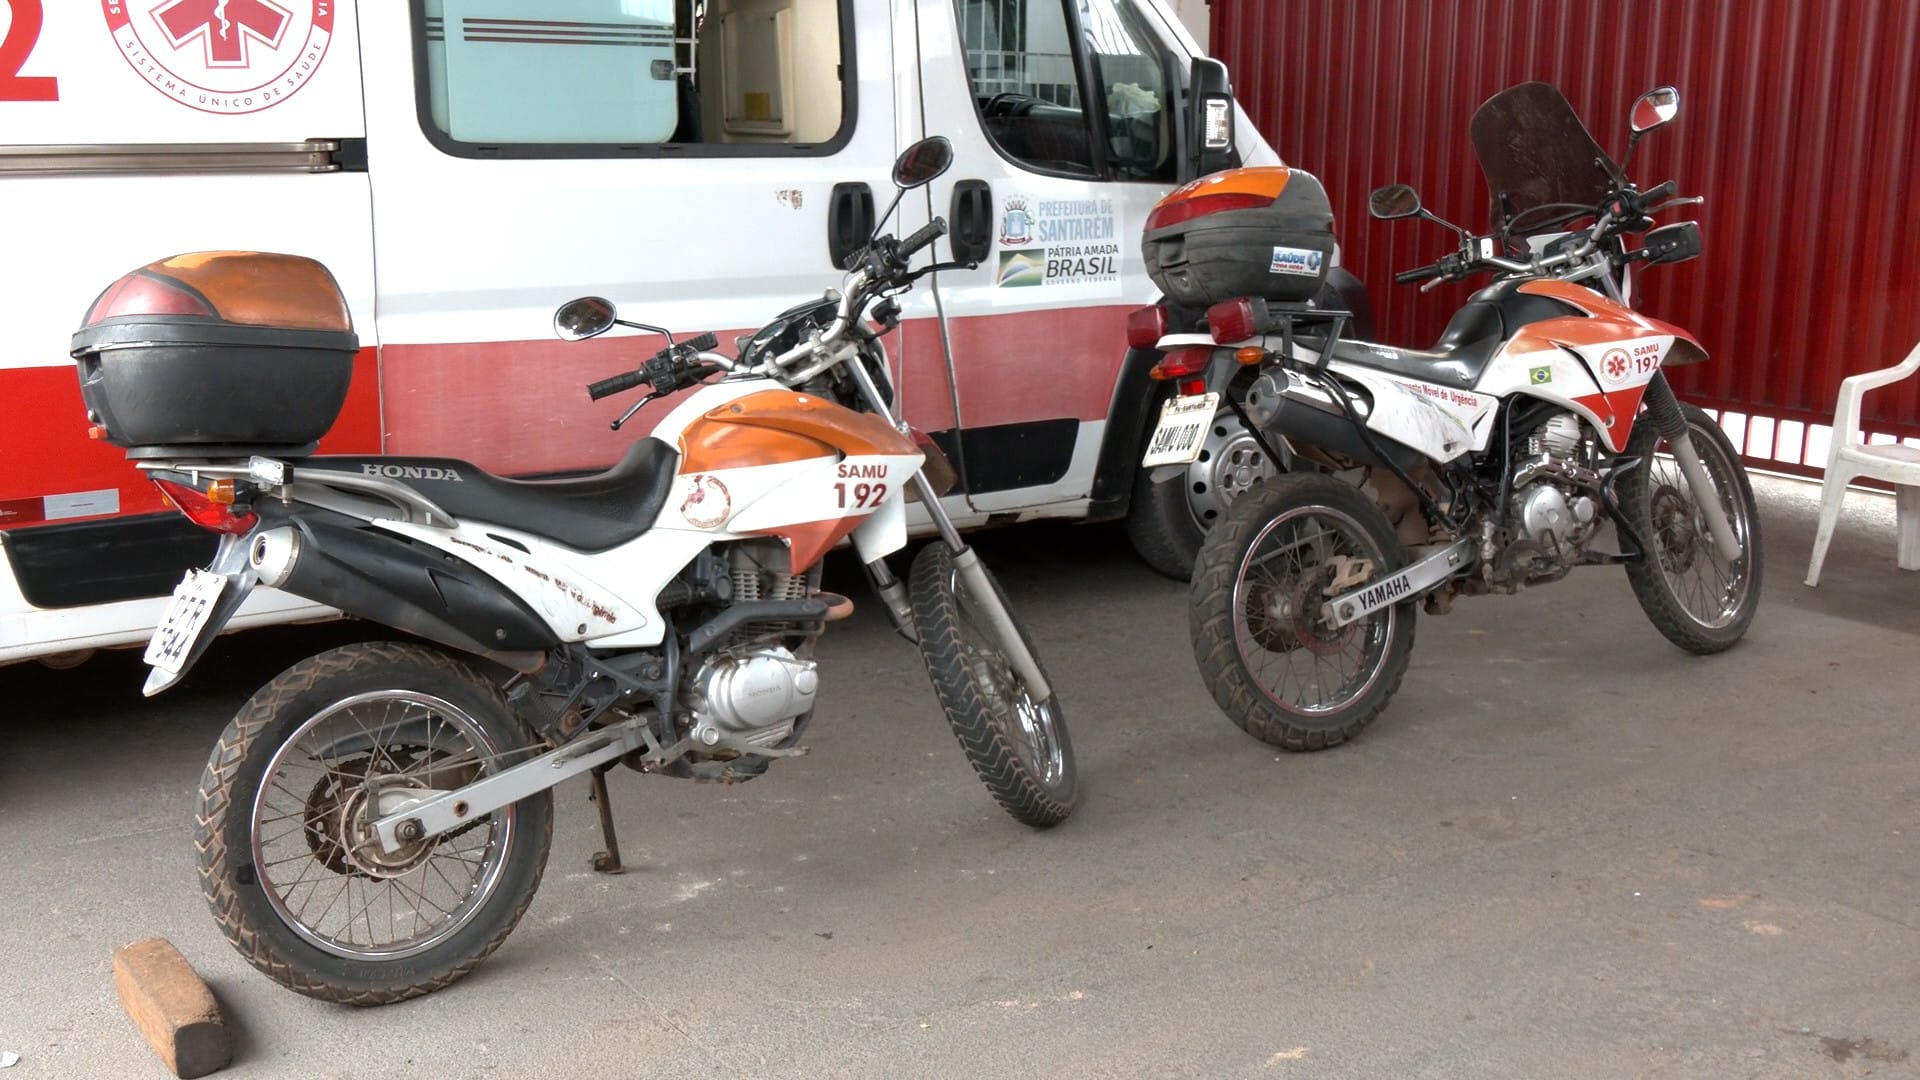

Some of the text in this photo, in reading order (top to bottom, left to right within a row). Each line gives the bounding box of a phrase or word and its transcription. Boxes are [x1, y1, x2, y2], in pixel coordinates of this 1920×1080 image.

[125, 41, 322, 108] SISTEMA ÚNICO DE SAÚDE
[1039, 199, 1113, 217] PREFEITURA DE
[1039, 216, 1114, 242] SANTARÉM
[1048, 244, 1119, 258] PÁTRIA AMADA
[1046, 256, 1117, 278] BRASIL
[1634, 343, 1659, 357] SAMU
[1635, 355, 1660, 374] 192
[361, 463, 464, 482] HONDA
[837, 464, 888, 479] SAMU
[833, 482, 888, 509] 192
[1358, 575, 1411, 610] YAMAHA
